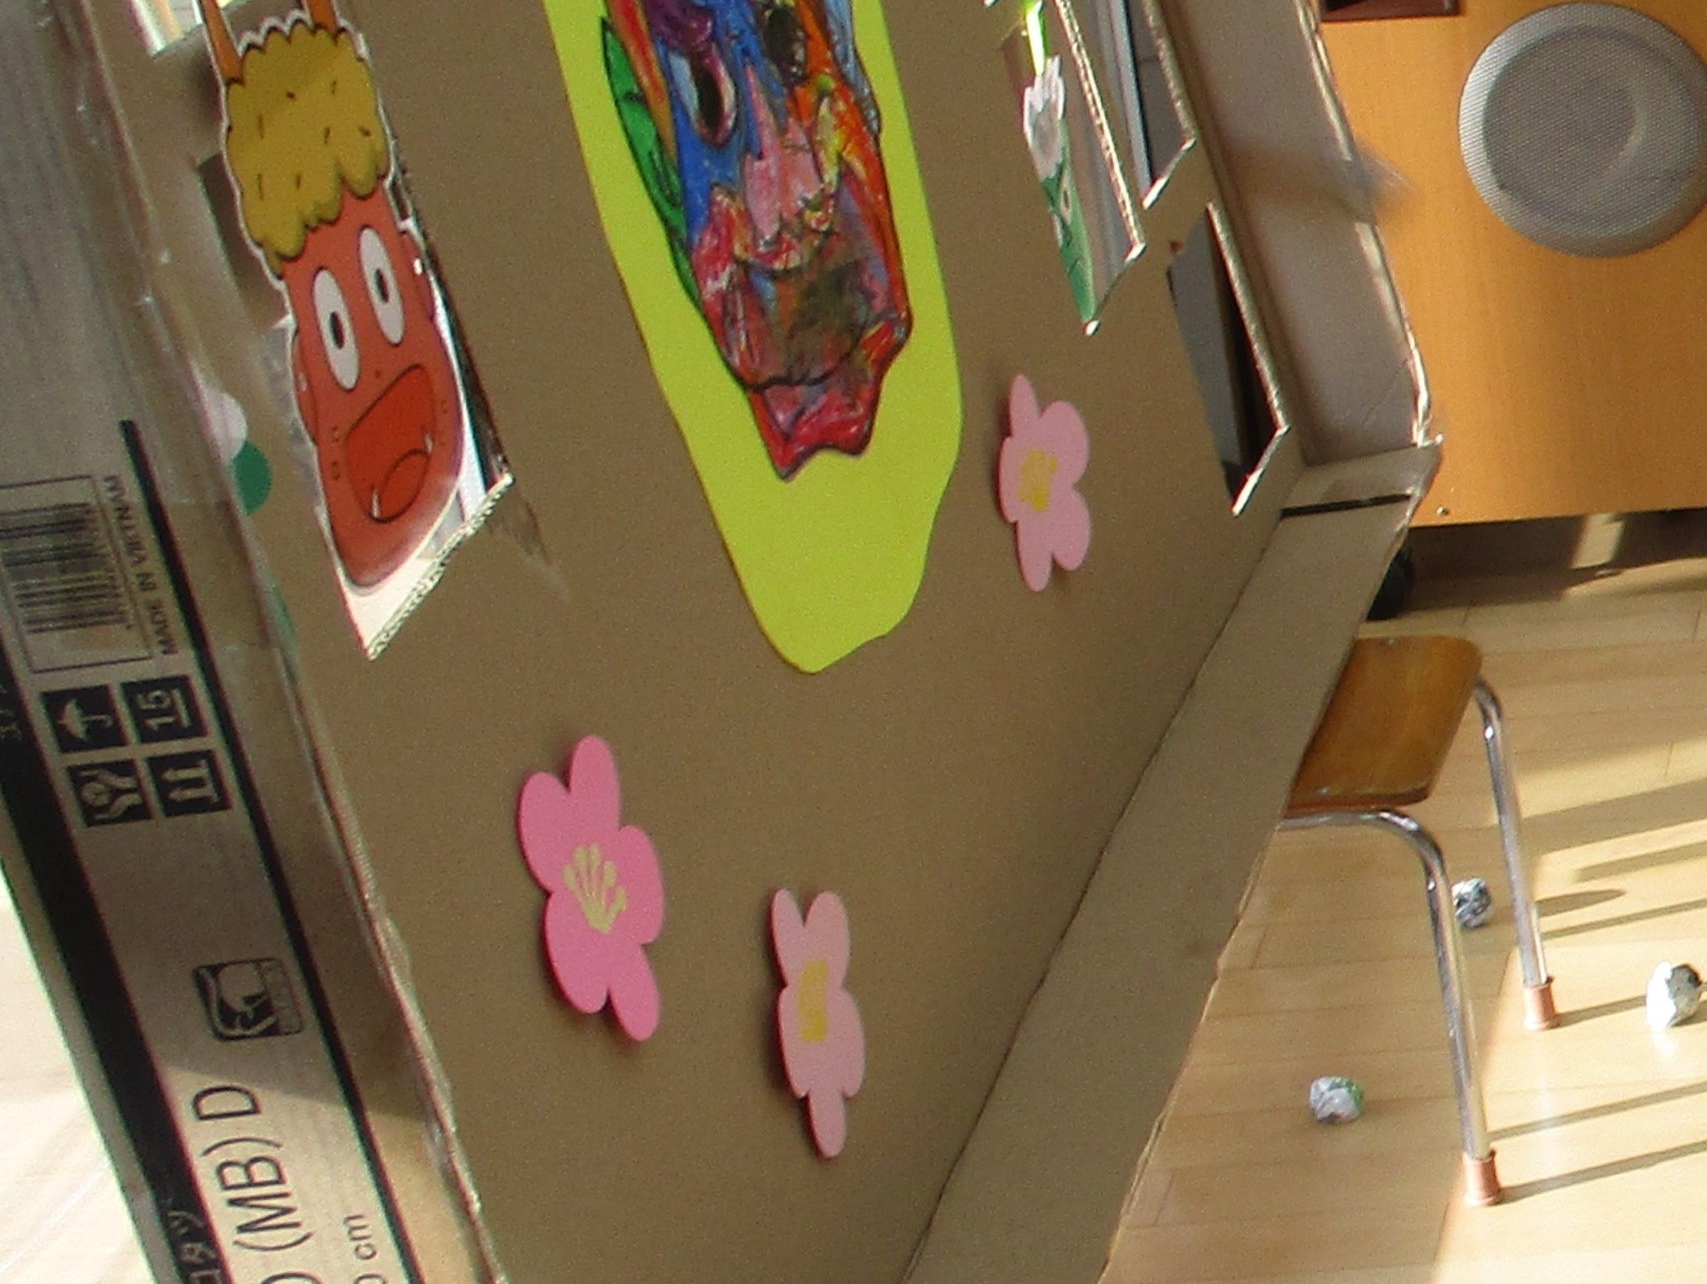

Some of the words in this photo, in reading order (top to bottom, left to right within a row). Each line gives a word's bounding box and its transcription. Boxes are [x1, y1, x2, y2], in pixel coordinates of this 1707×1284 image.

[103, 474, 149, 567] VIETNAM
[136, 570, 159, 593] IN
[148, 597, 179, 656] MADE
[193, 1083, 263, 1122] D
[201, 1136, 313, 1252] (MB)
[344, 1214, 381, 1261] cm
